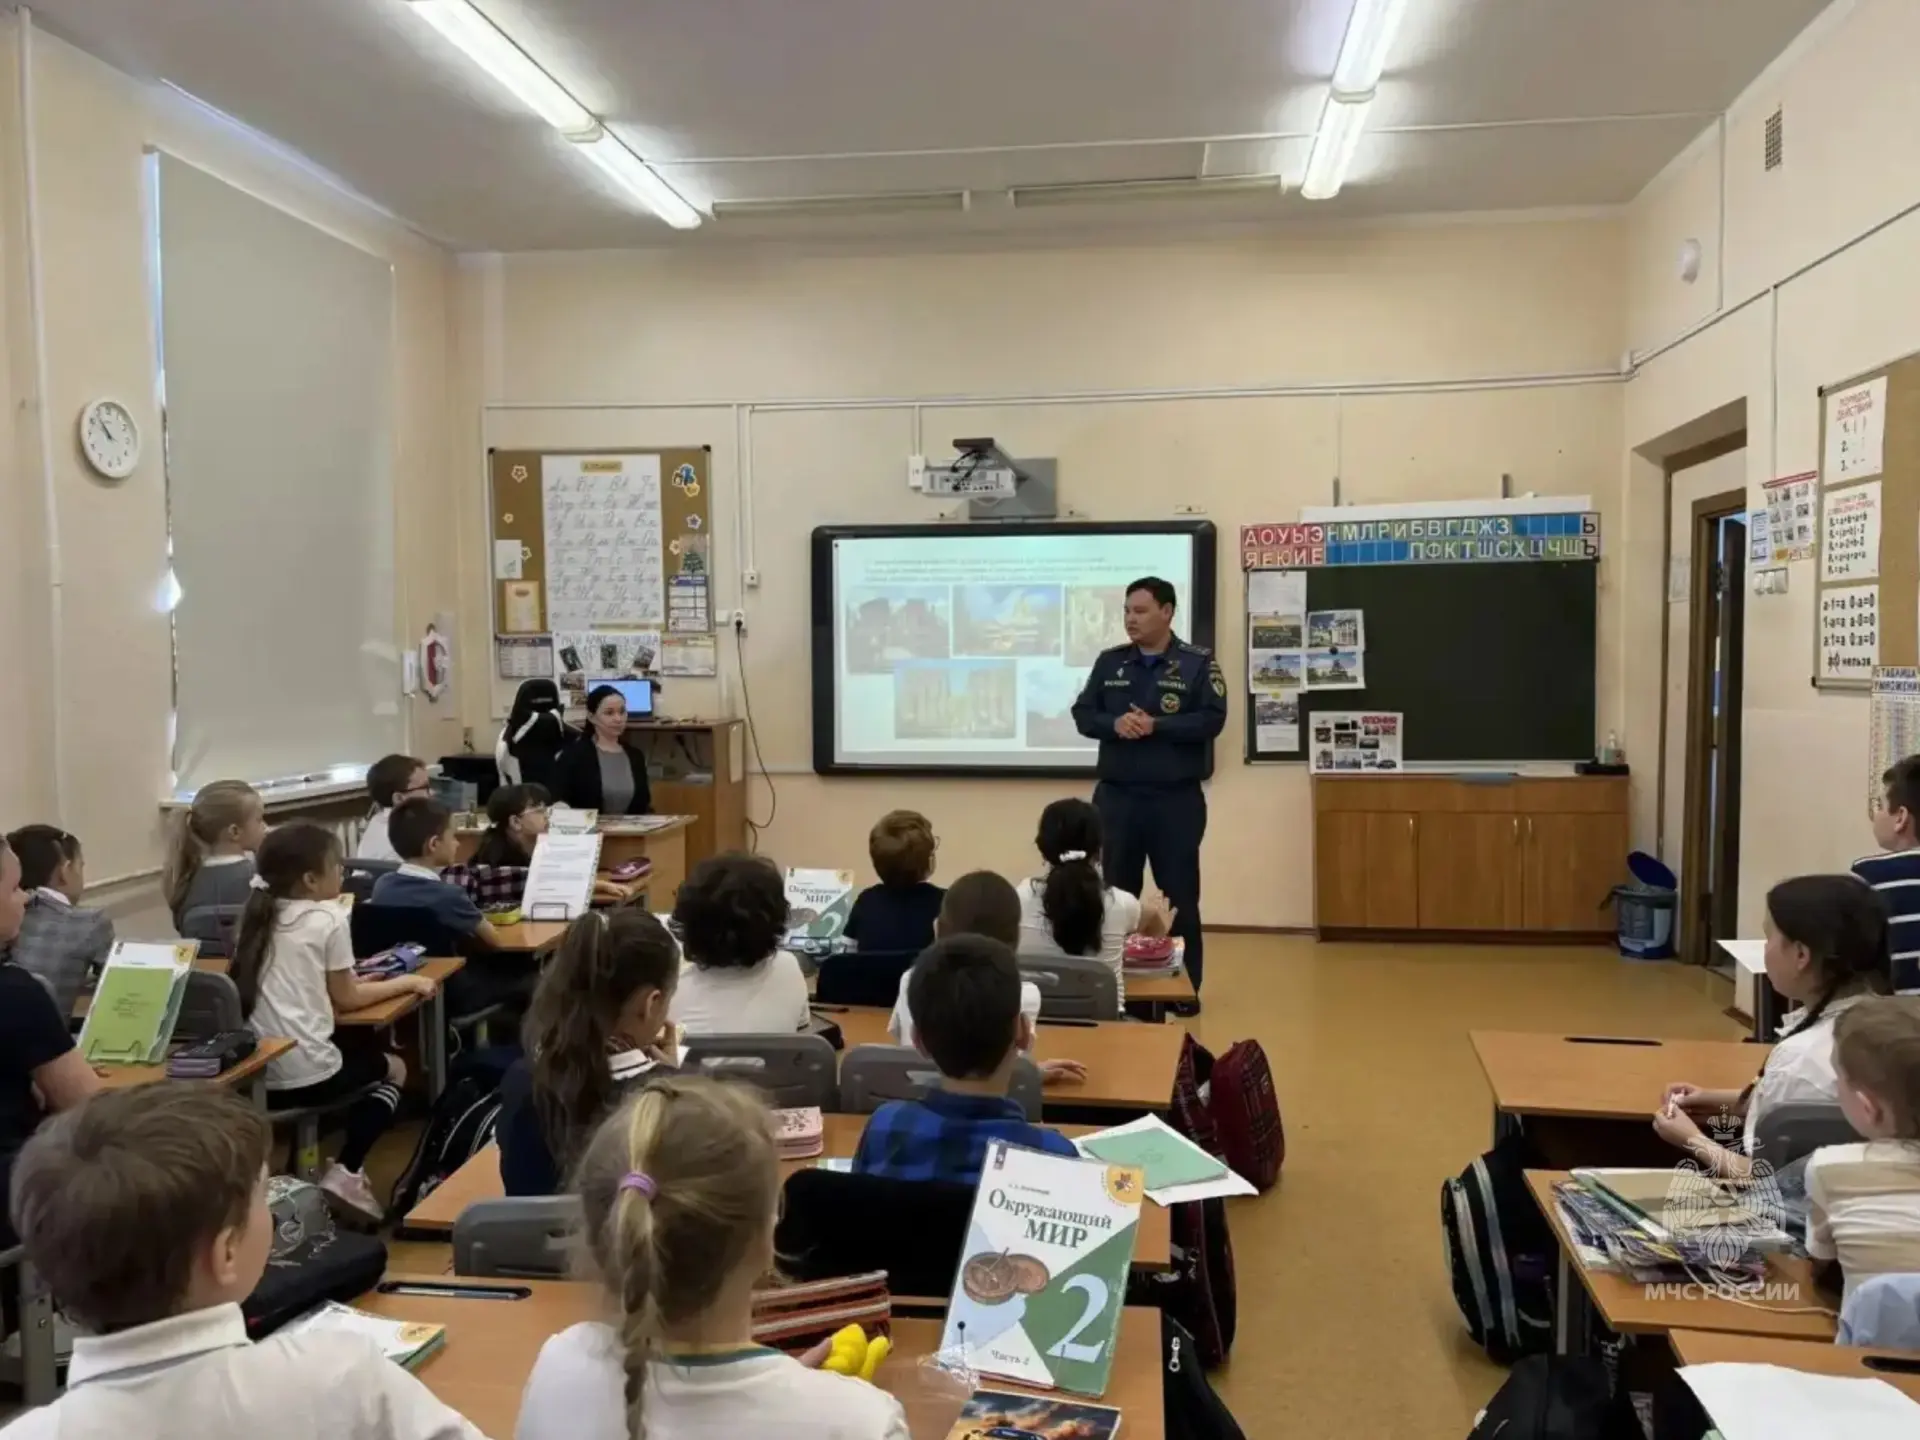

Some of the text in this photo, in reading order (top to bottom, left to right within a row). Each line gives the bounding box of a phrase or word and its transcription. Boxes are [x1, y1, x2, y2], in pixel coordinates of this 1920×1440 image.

[988, 1188, 1112, 1229] Окружающий
[1023, 1218, 1088, 1249] МИР
[1046, 1273, 1109, 1364] 2
[990, 1349, 1021, 1365] Часть
